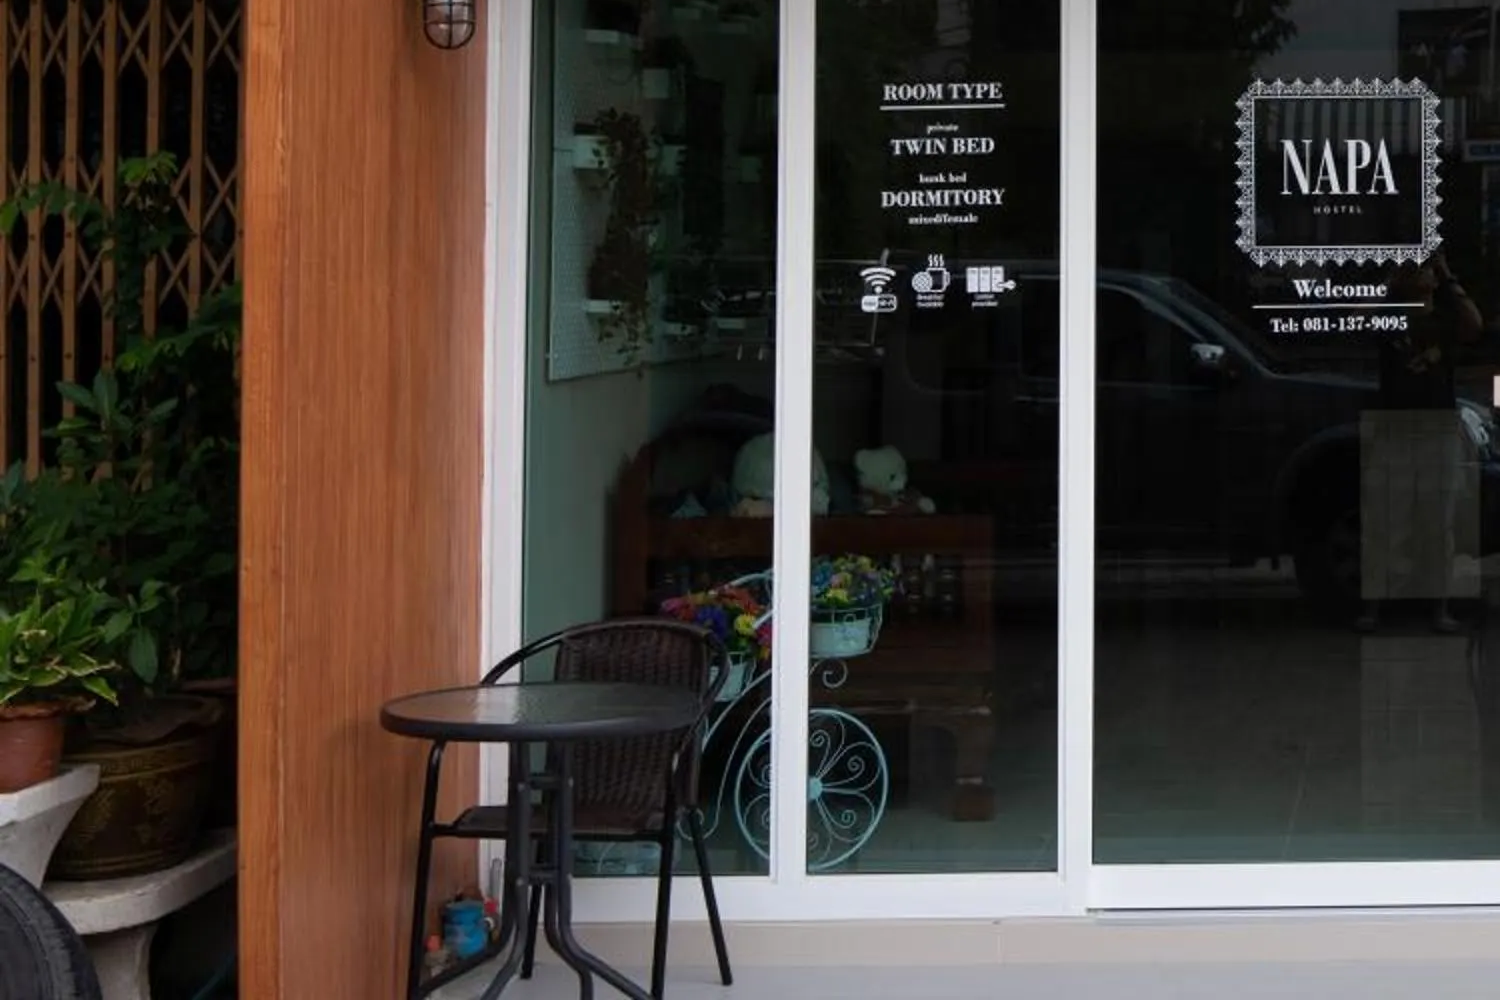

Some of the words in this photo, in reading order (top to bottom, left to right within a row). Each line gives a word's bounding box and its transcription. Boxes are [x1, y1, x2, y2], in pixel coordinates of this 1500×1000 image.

[883, 83, 943, 101] ROOM
[948, 81, 1003, 100] TYPE
[890, 138, 947, 156] TWIN
[952, 137, 995, 155] BED
[1280, 137, 1400, 196] NAPA
[948, 172, 967, 184] bed
[881, 188, 1005, 208] DORMITORY
[1313, 205, 1364, 215] HOSTEL
[1291, 278, 1388, 299] Welcome
[1269, 317, 1299, 333] Tel:
[1302, 315, 1409, 332] 081-137-9095
